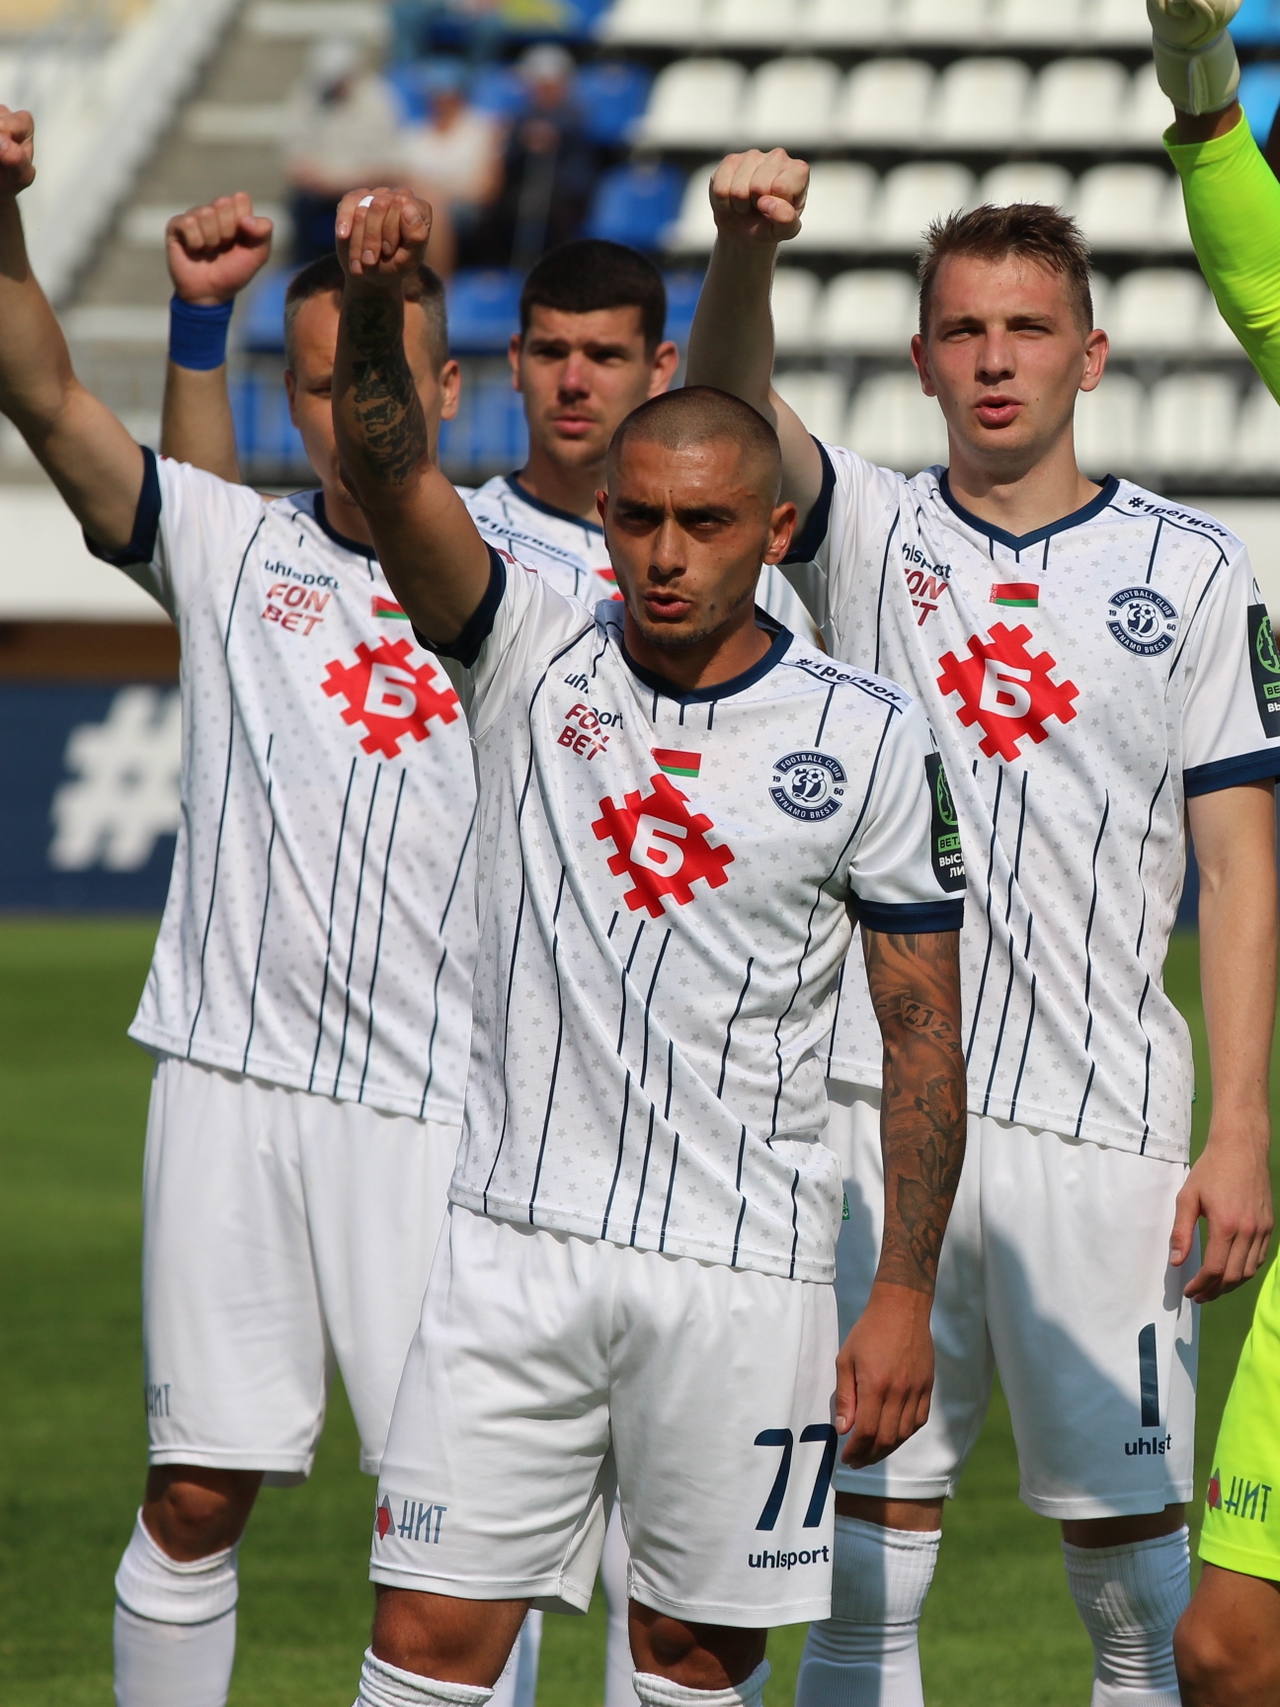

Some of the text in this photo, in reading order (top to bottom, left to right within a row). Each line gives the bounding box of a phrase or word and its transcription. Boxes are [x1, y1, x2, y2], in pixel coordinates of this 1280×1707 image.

[266, 583, 331, 613] FON
[904, 568, 949, 600] ON
[1115, 590, 1173, 616] FOOTBALL CLUB
[261, 603, 324, 637] BET
[1112, 625, 1168, 654] DYNAMO BREST
[362, 662, 418, 720] Б
[979, 657, 1032, 719] Б
[557, 725, 608, 761] BET
[781, 754, 843, 778] FOOTBALL CLUB
[772, 775, 844, 796] 19 60
[774, 791, 834, 819] DYNAMO BREST
[629, 814, 688, 878] Б
[938, 853, 964, 867] ВЫС
[754, 1423, 838, 1531] 77
[748, 1545, 830, 1571] uhlsport
